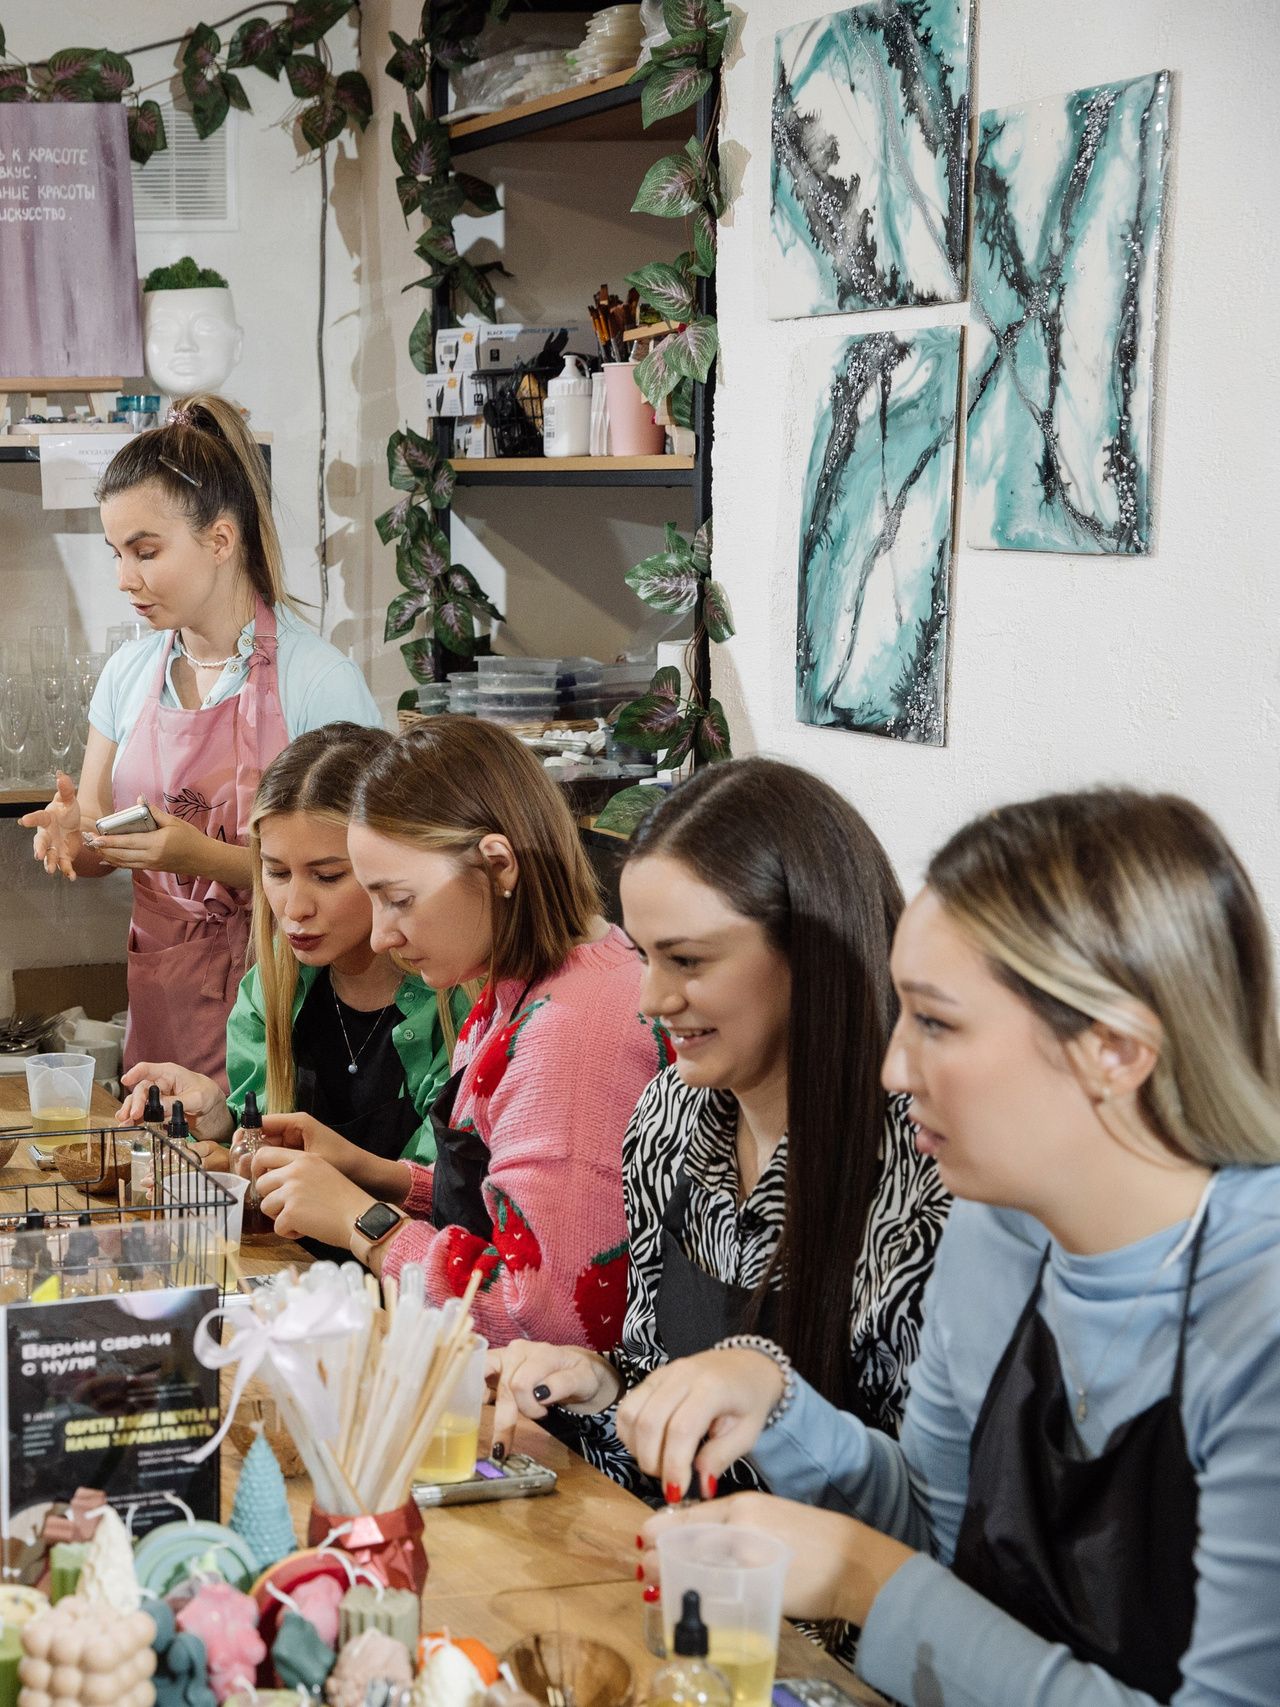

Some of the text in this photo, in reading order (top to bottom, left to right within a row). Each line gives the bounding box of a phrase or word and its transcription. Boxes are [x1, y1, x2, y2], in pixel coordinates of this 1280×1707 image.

[12, 148, 21, 163] К
[28, 147, 88, 166] КРАСОТЕ
[37, 184, 96, 200] КРАСОТЫ
[21, 1331, 172, 1361] Варим свечи
[21, 1355, 97, 1377] с нуля
